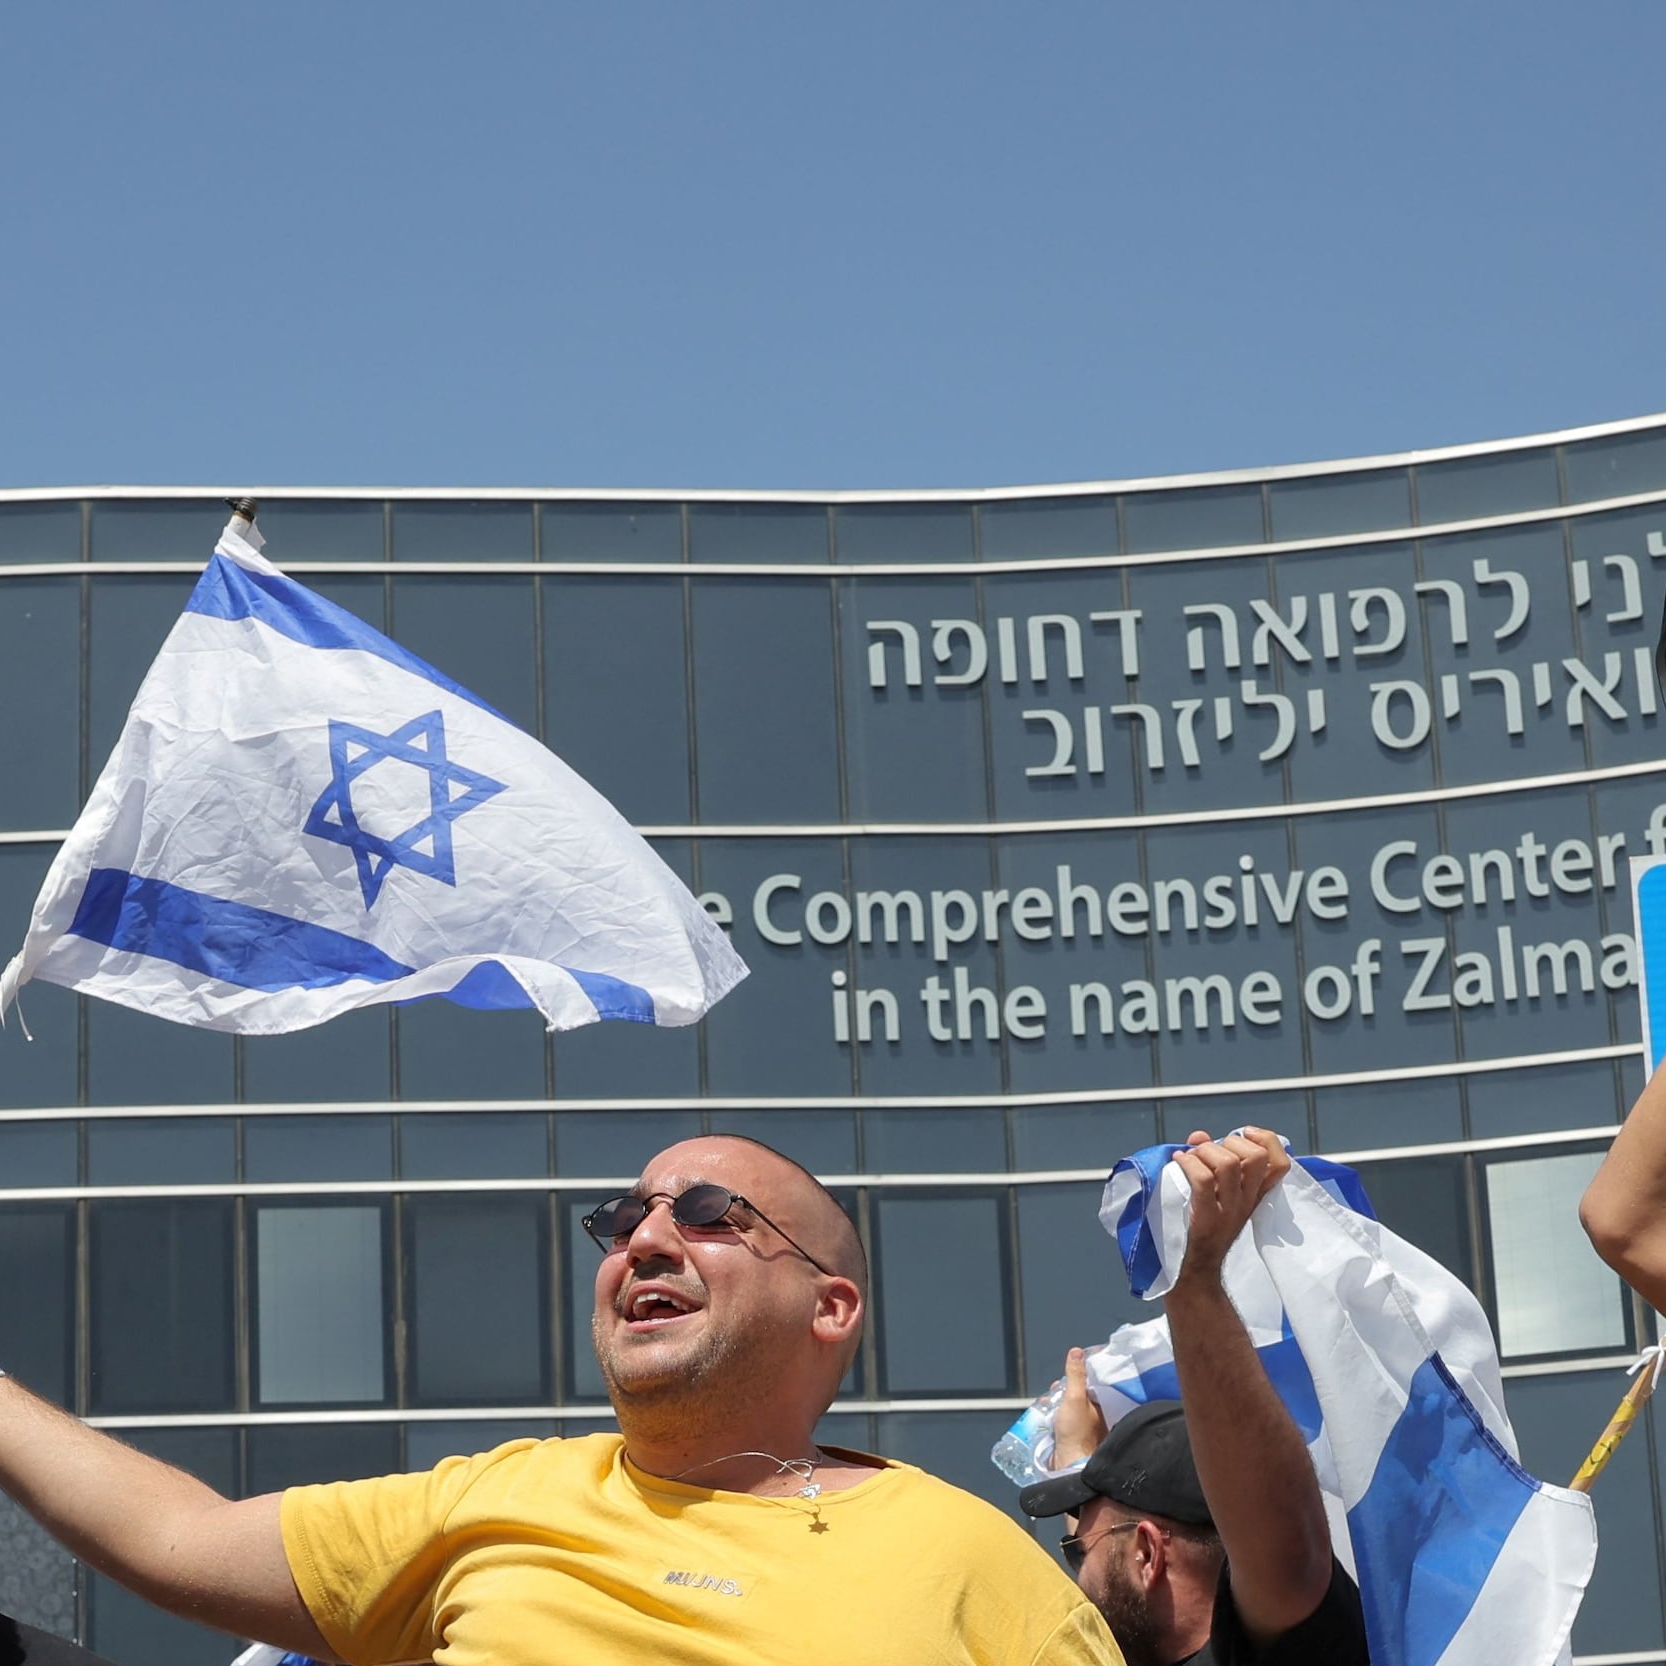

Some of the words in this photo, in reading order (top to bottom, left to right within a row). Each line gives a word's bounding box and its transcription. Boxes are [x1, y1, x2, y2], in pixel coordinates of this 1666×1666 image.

[866, 608, 1143, 688] דחופה
[1183, 558, 1531, 672] לרפואה
[1022, 680, 1327, 777] יליזרוב
[752, 854, 1350, 962] Comprehensive
[1370, 831, 1626, 914] Center
[830, 968, 902, 1044] in
[922, 966, 1047, 1042] the
[1068, 967, 1283, 1036] name
[1303, 936, 1382, 1022] of
